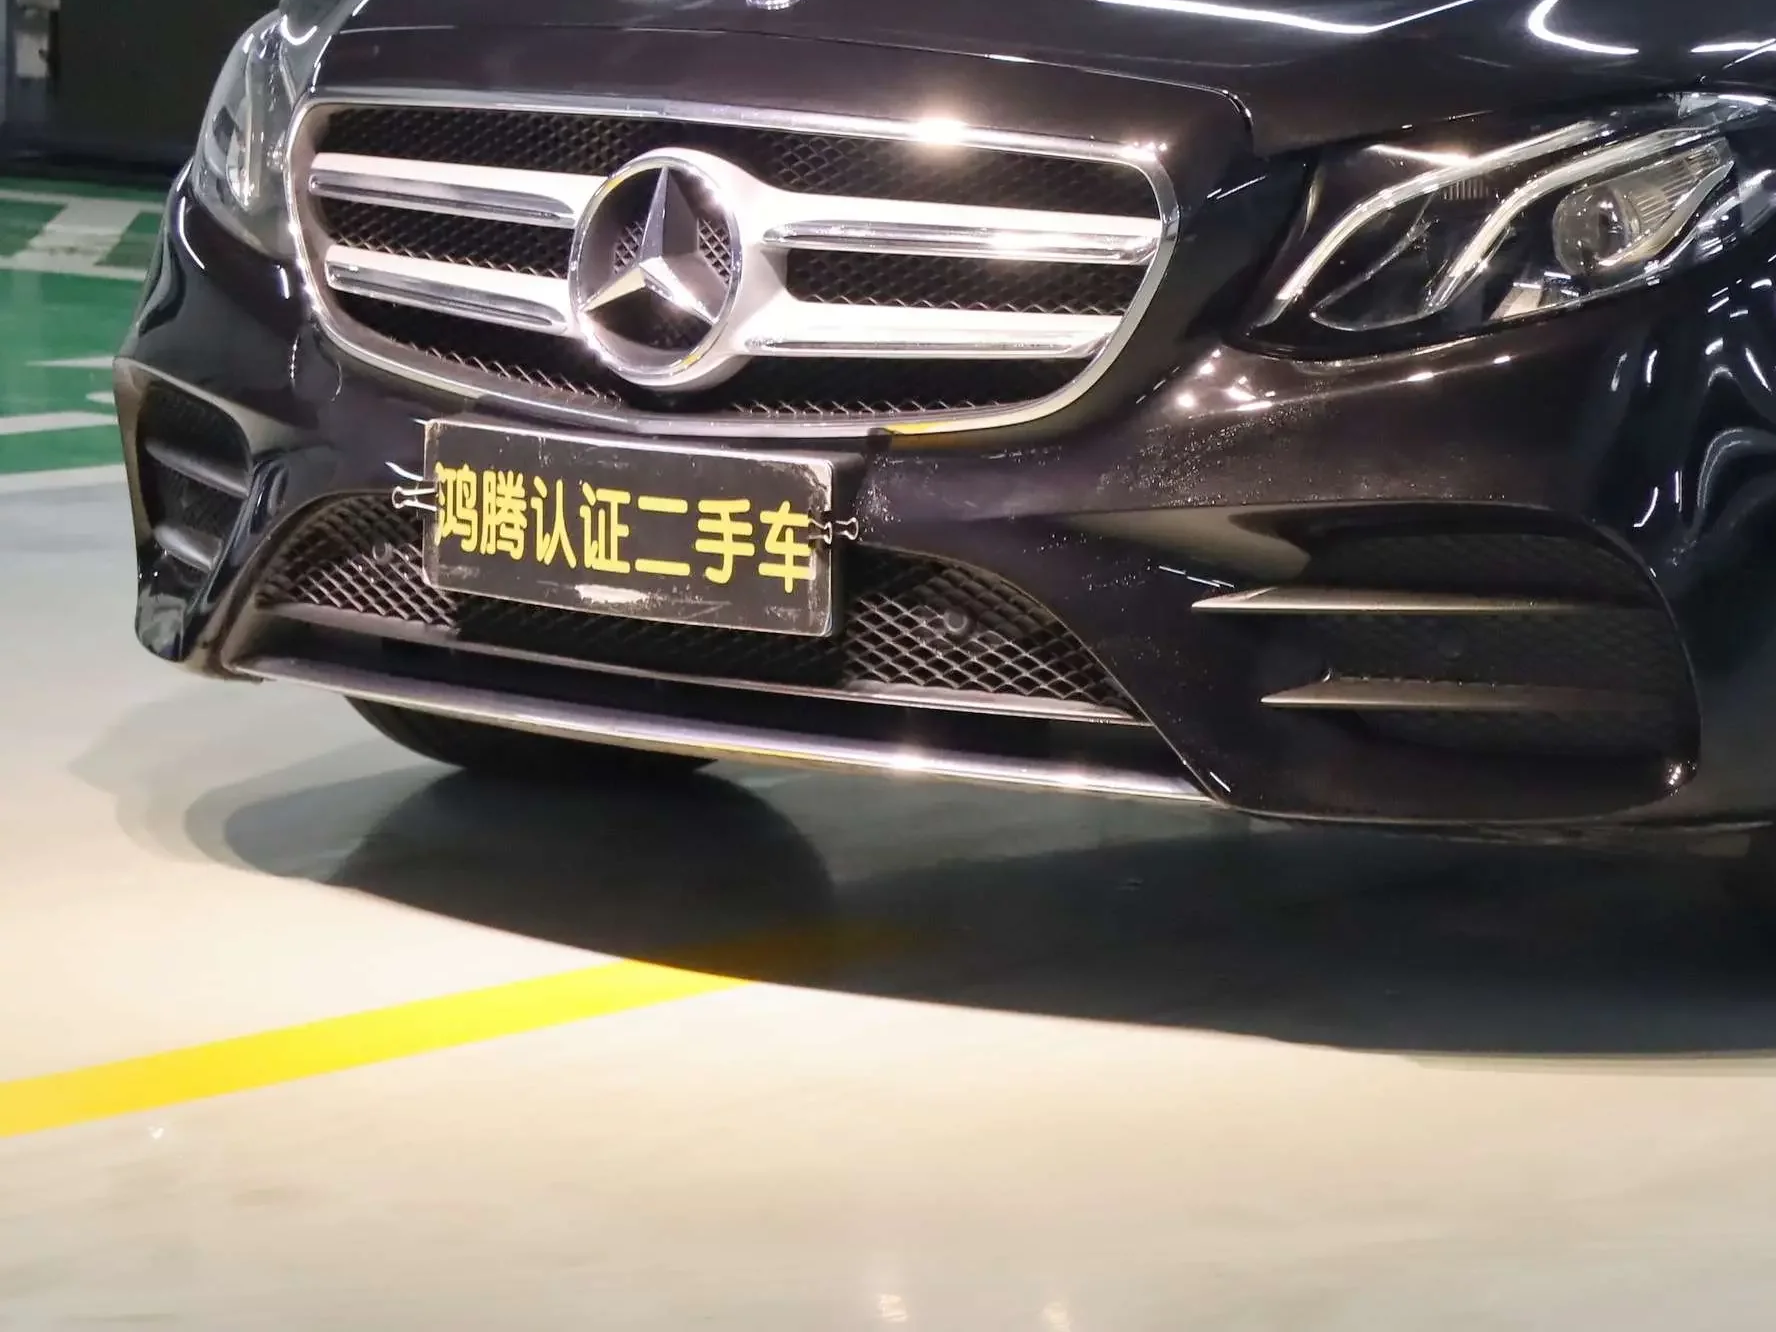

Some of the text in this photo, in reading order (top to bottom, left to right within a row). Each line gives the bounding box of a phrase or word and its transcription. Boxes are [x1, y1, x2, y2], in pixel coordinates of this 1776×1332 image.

[433, 461, 816, 594] 鸿腾认证二手车
